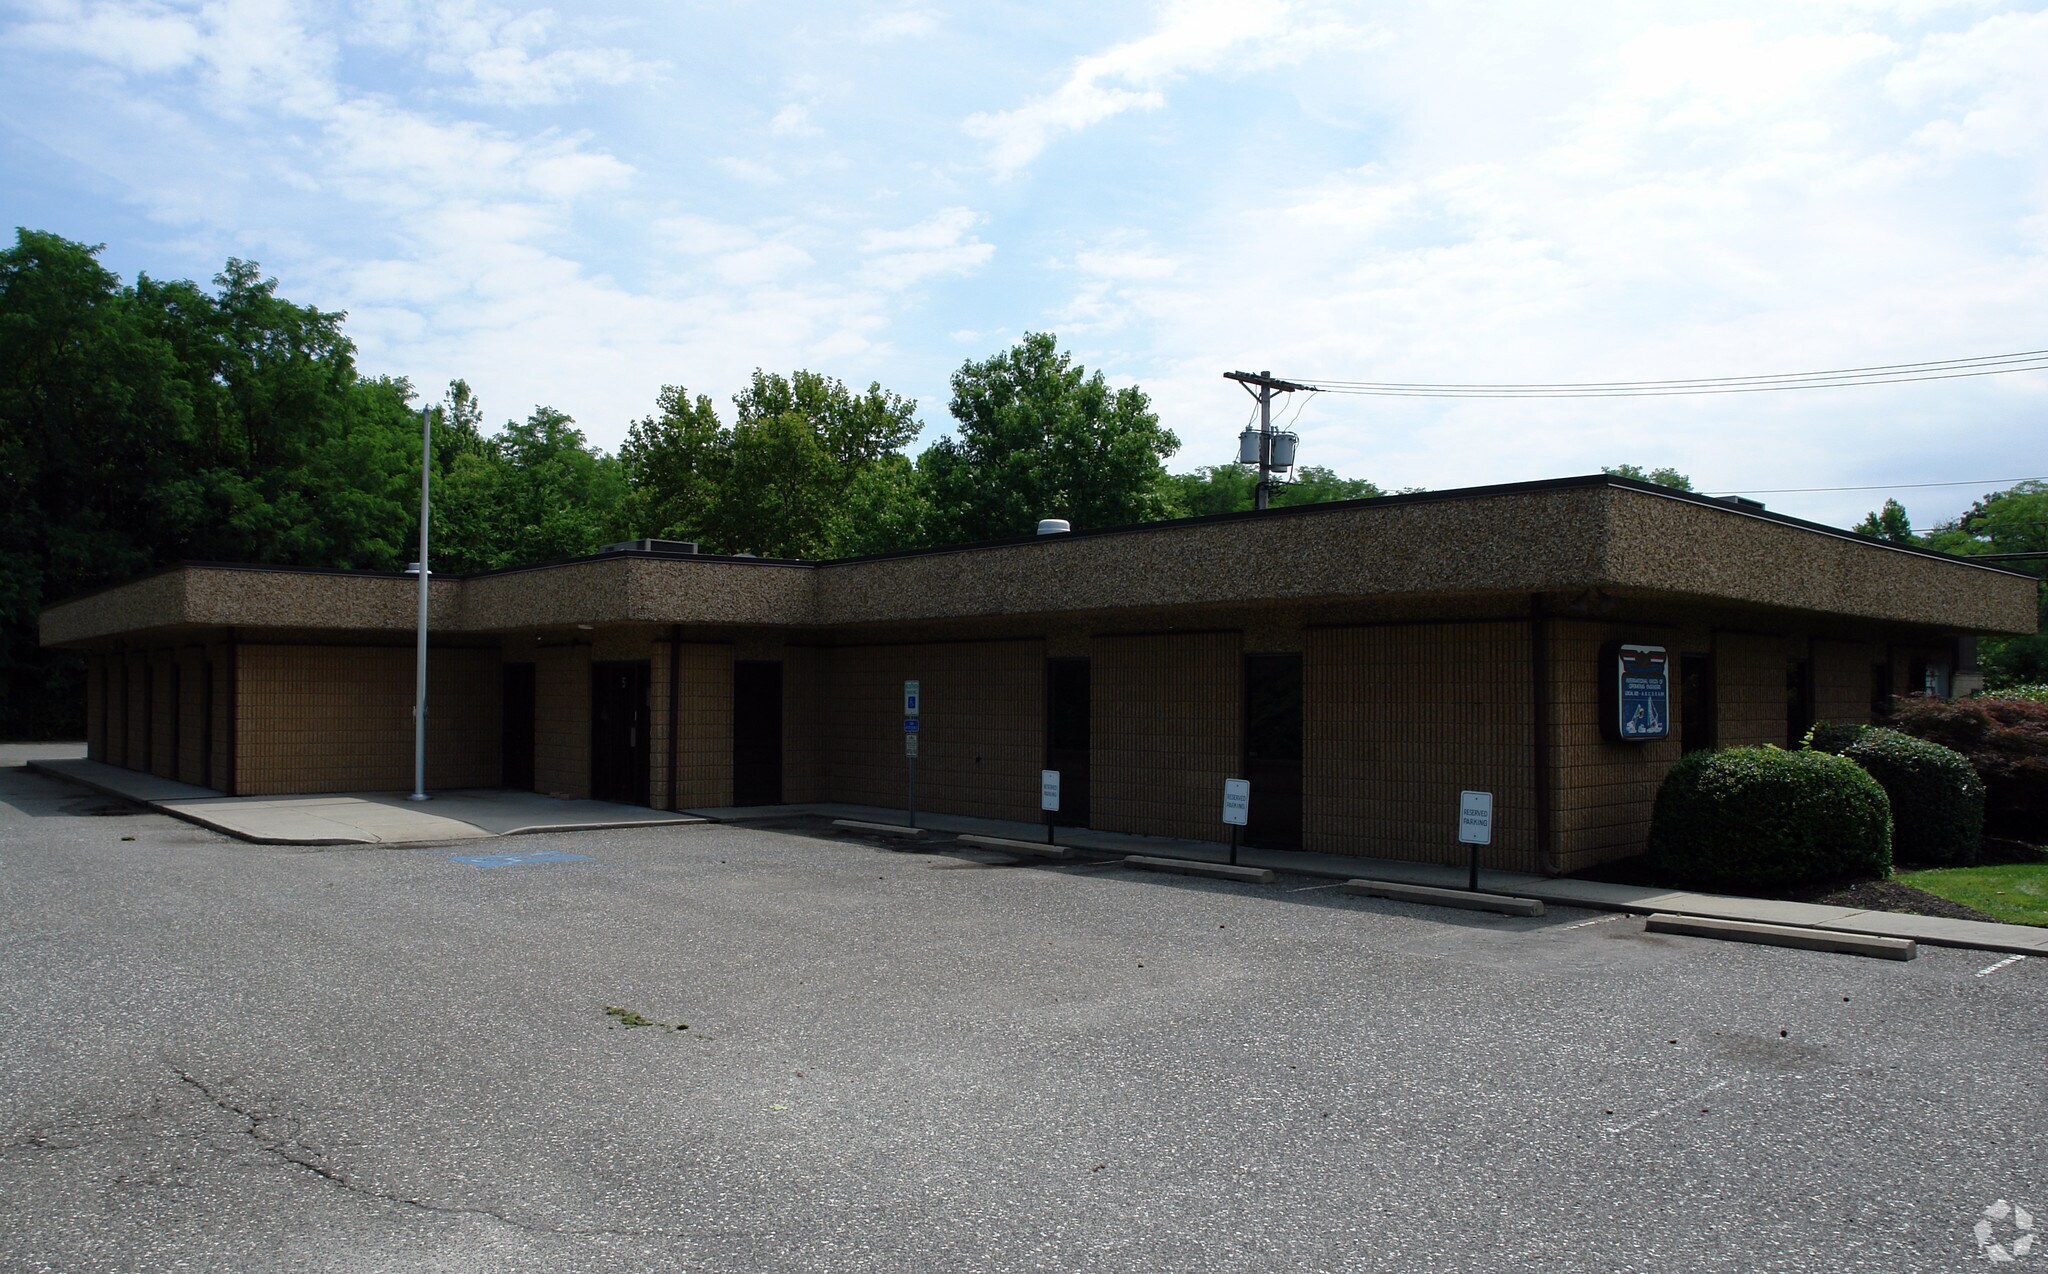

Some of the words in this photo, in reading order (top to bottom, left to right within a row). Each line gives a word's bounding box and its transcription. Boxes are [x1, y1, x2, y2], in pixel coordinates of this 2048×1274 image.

[1227, 793, 1246, 802] RESERVED
[1226, 801, 1245, 810] PARKING
[1464, 808, 1488, 818] RESERVED
[1463, 817, 1488, 827] PARKING
